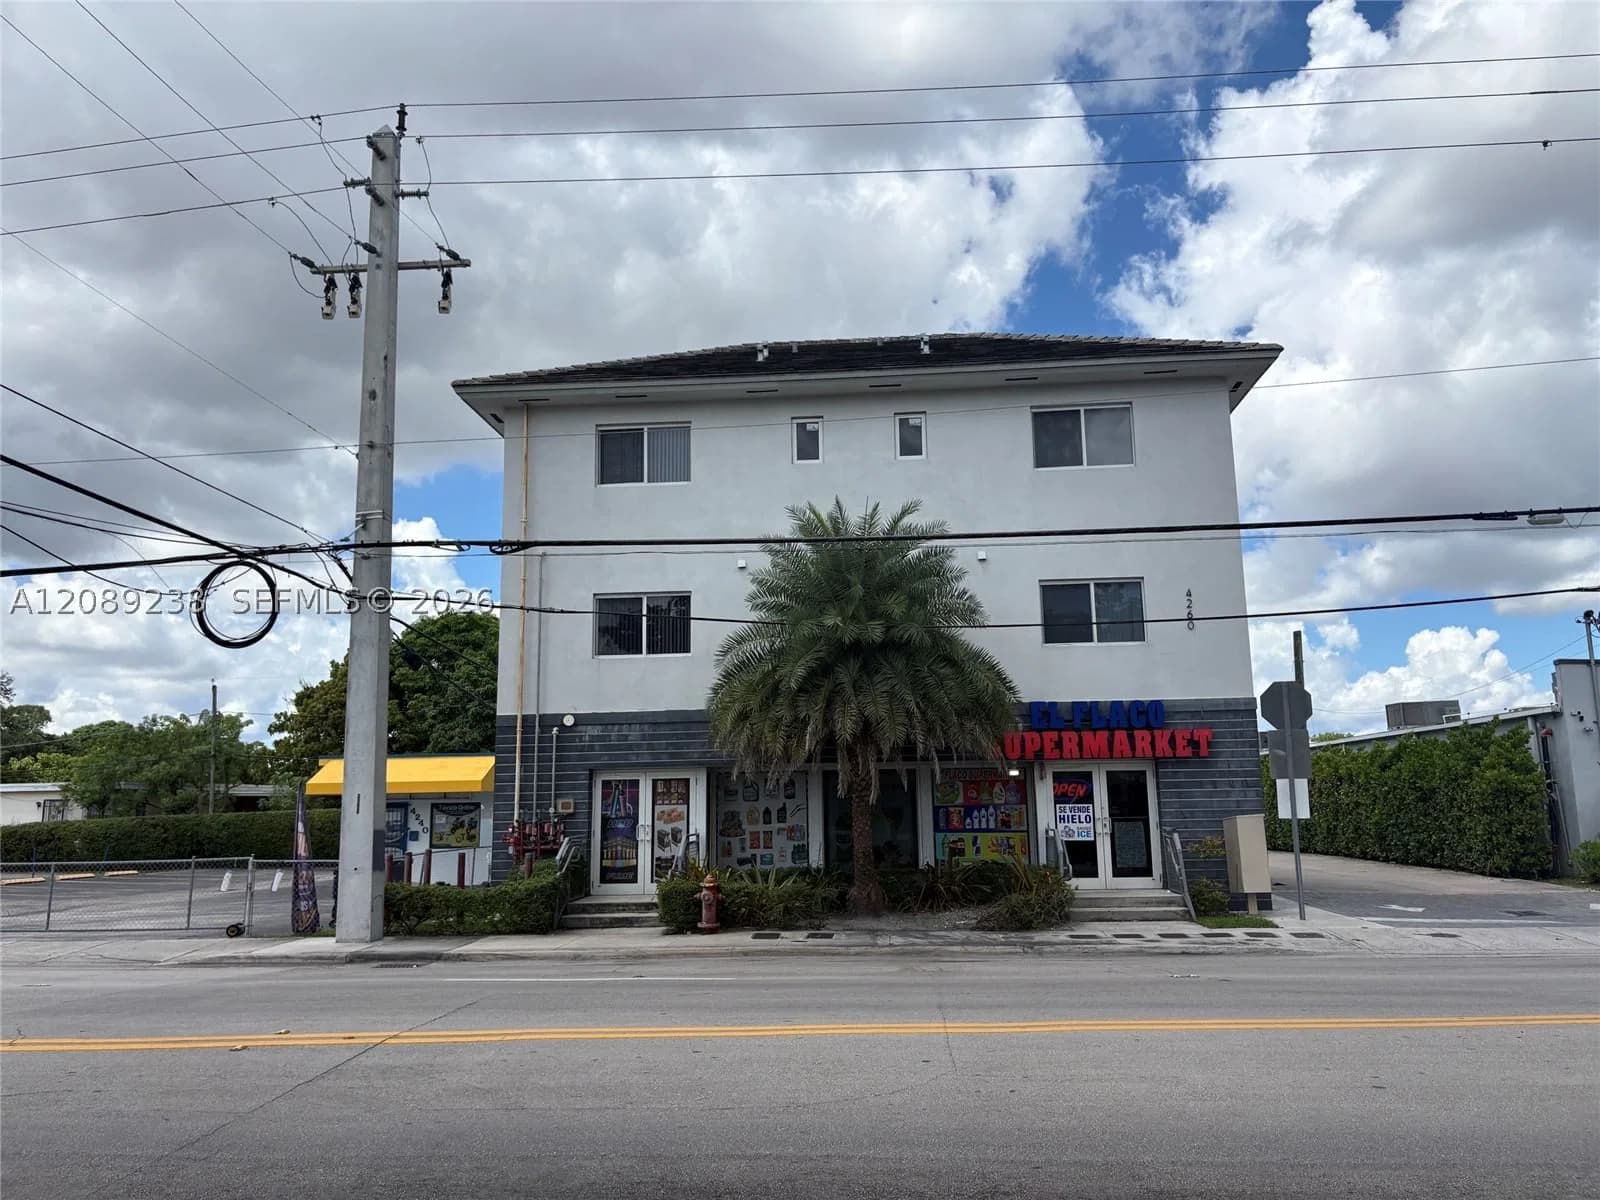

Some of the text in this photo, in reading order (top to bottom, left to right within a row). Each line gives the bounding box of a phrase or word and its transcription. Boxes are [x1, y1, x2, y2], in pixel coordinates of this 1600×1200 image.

[1186, 588, 1195, 630] 4260
[1029, 699, 1166, 728] EL FLACO
[996, 728, 1213, 759] UPERMARKET
[1059, 806, 1091, 814] SE VENDE
[1059, 814, 1092, 824] HIELO
